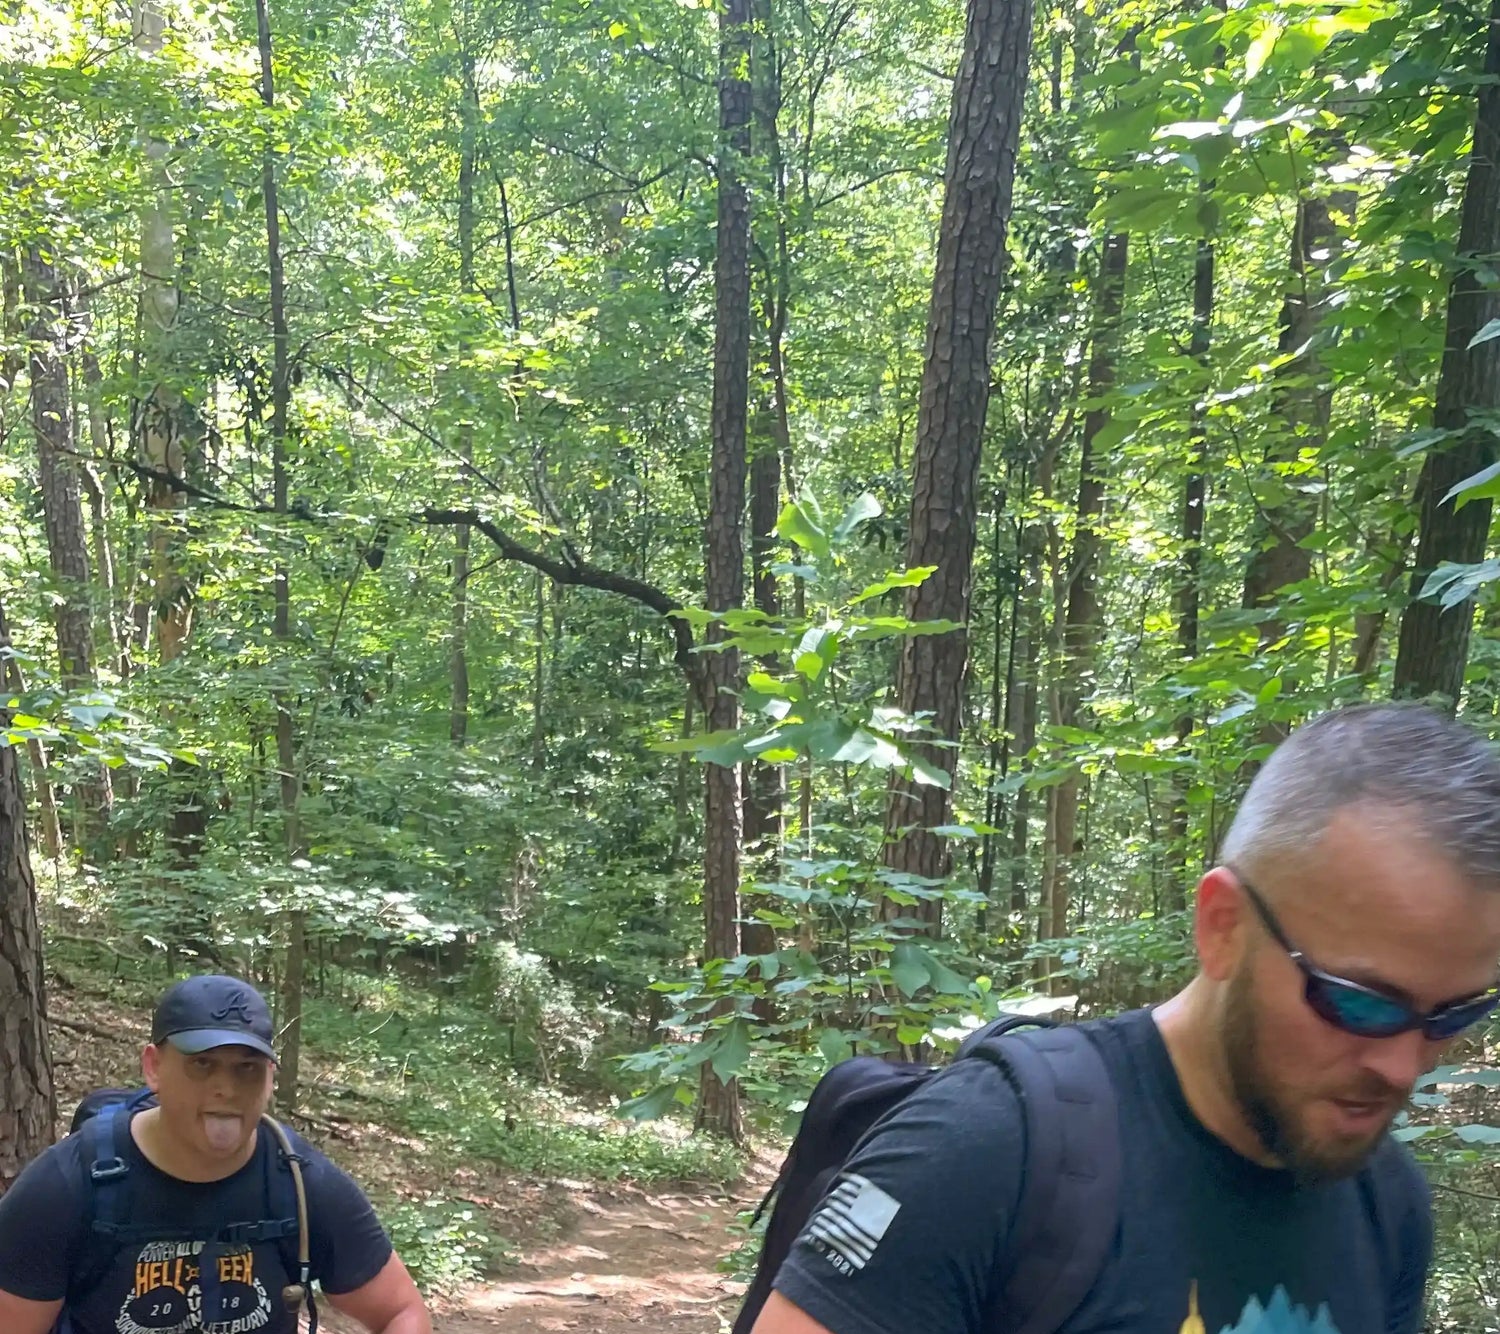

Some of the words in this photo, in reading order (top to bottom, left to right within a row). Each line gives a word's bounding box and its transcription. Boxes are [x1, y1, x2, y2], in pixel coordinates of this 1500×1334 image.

[150, 1302, 172, 1316] 20
[222, 1296, 240, 1309] 18
[187, 1284, 202, 1327] RUN
[231, 1306, 269, 1333] BURN
